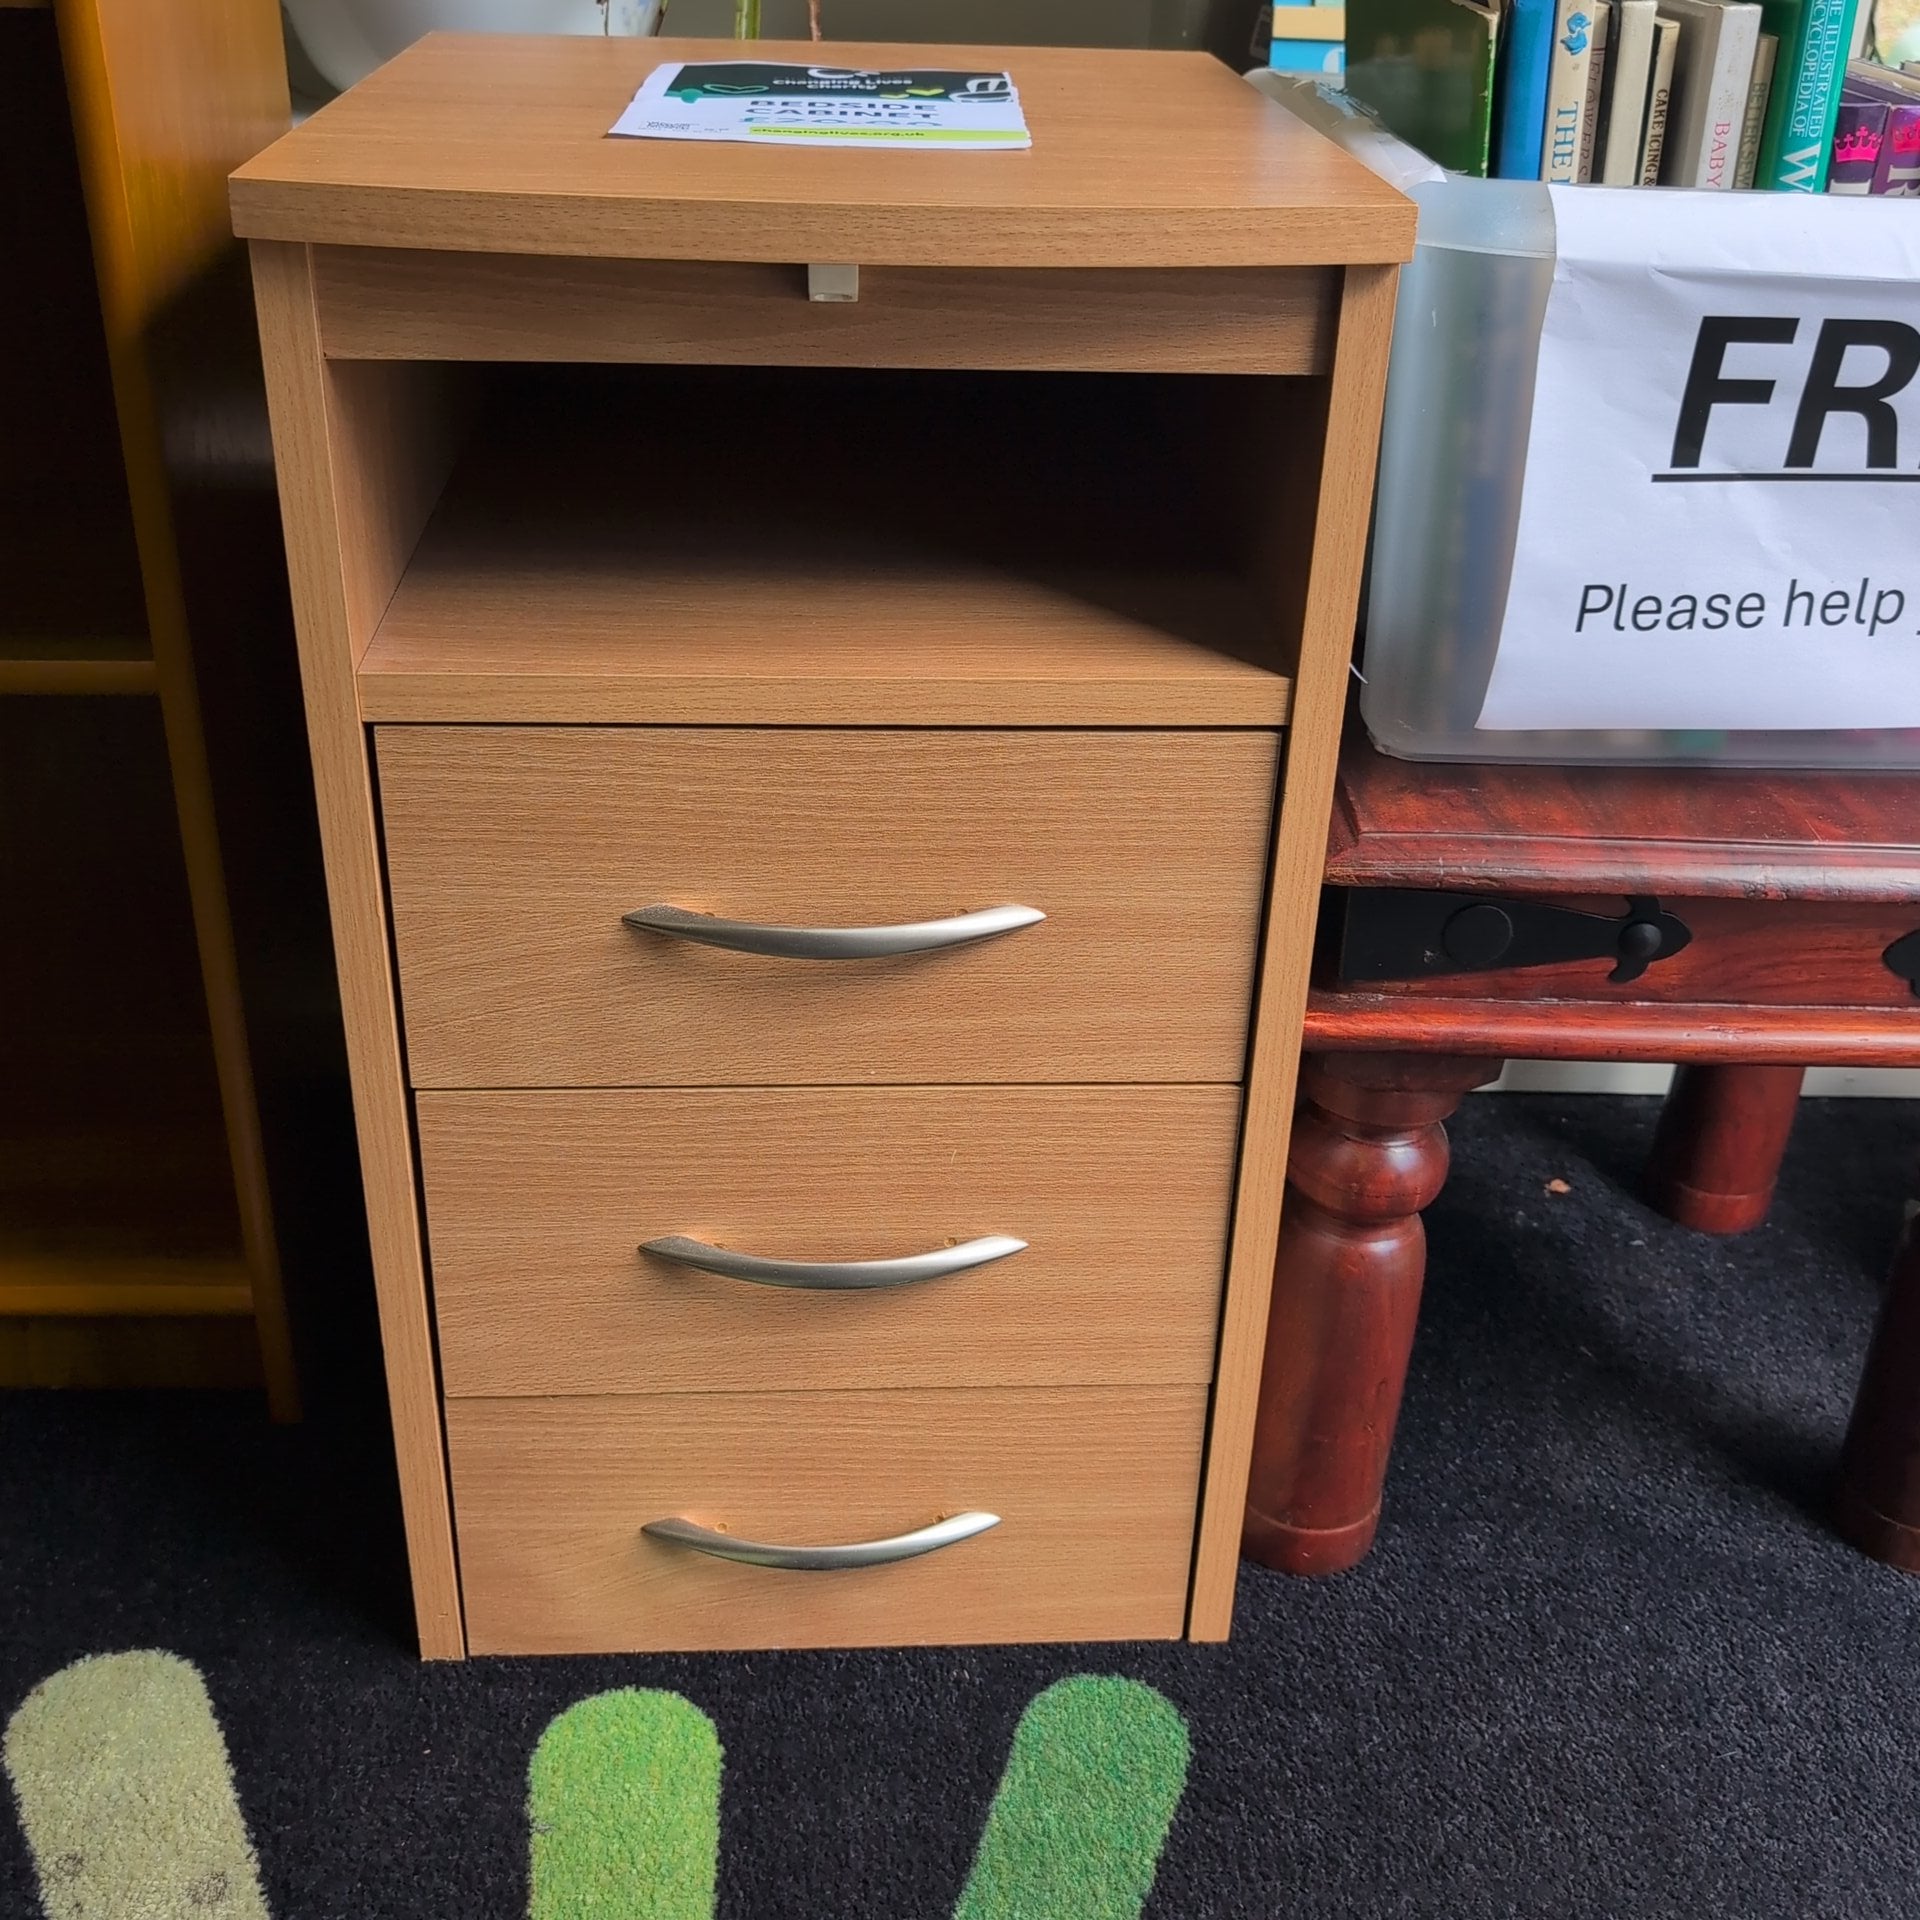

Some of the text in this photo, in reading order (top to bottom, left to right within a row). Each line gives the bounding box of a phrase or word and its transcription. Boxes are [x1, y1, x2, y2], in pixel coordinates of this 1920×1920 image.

[744, 108, 940, 119] CABINET
[749, 100, 937, 112] BEDSIDE
[1808, 24, 1839, 139] ILLUSTRATED
[1551, 100, 1579, 169] THE
[1642, 88, 1668, 187] CAKE ICING &
[1706, 120, 1731, 188] BABY
[1792, 115, 1807, 138] OF
[1669, 315, 1920, 469] FR
[1575, 577, 1905, 637] Please help
